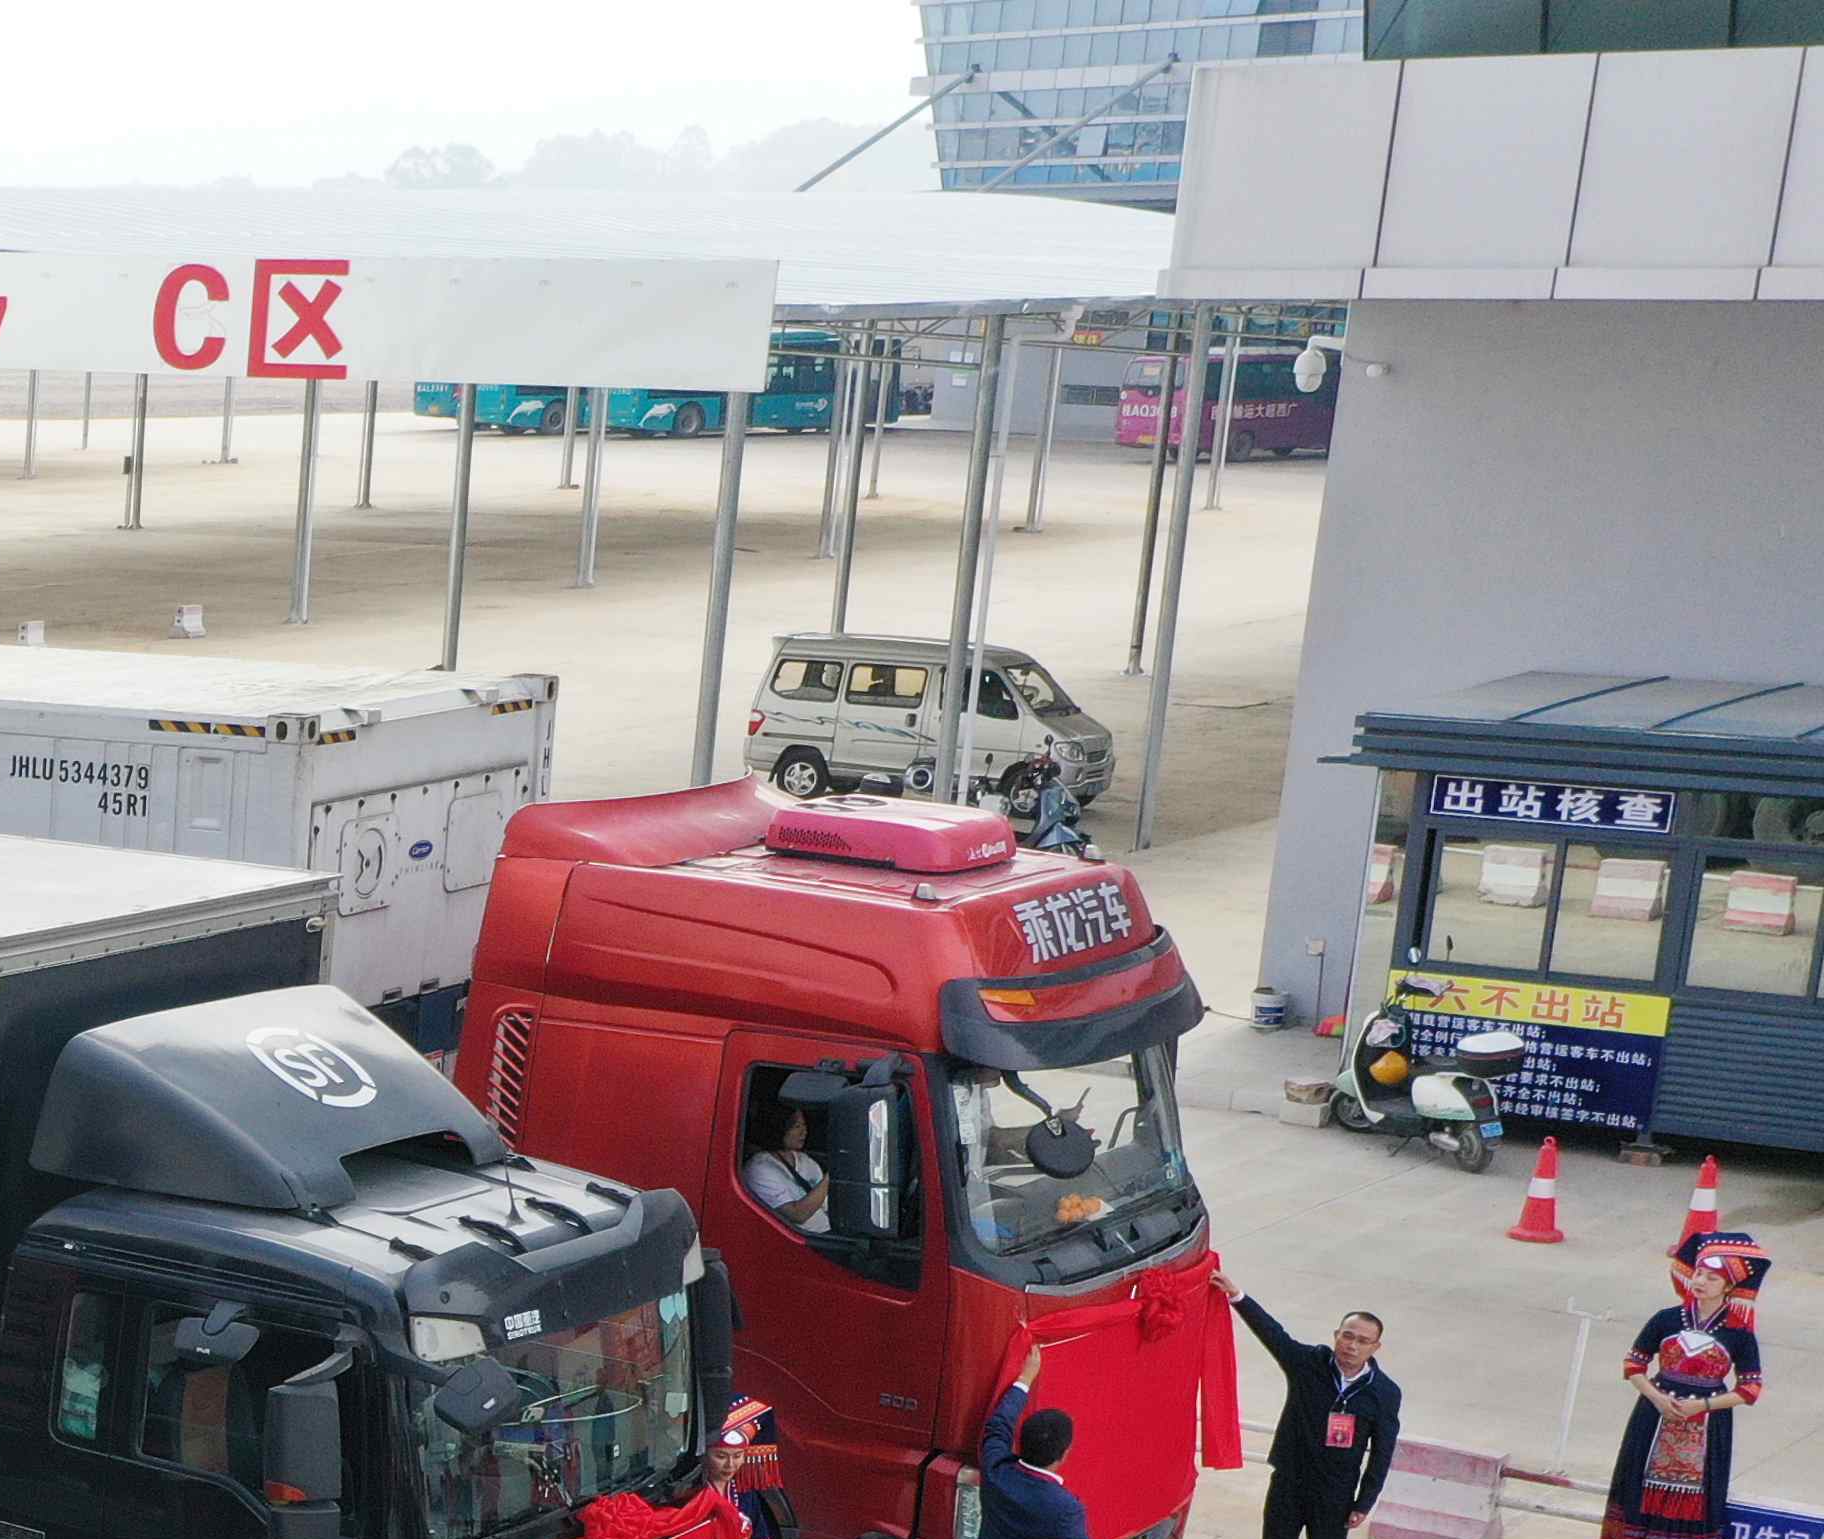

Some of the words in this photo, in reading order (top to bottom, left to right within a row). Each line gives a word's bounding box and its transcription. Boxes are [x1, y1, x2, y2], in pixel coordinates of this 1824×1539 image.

[153, 258, 349, 379] C区
[9, 754, 54, 781] JHLU
[58, 759, 149, 790] 5344379
[97, 791, 148, 818] 45R1
[1443, 780, 1664, 829] 出站核查
[1012, 881, 1132, 964] 乘龙汽车
